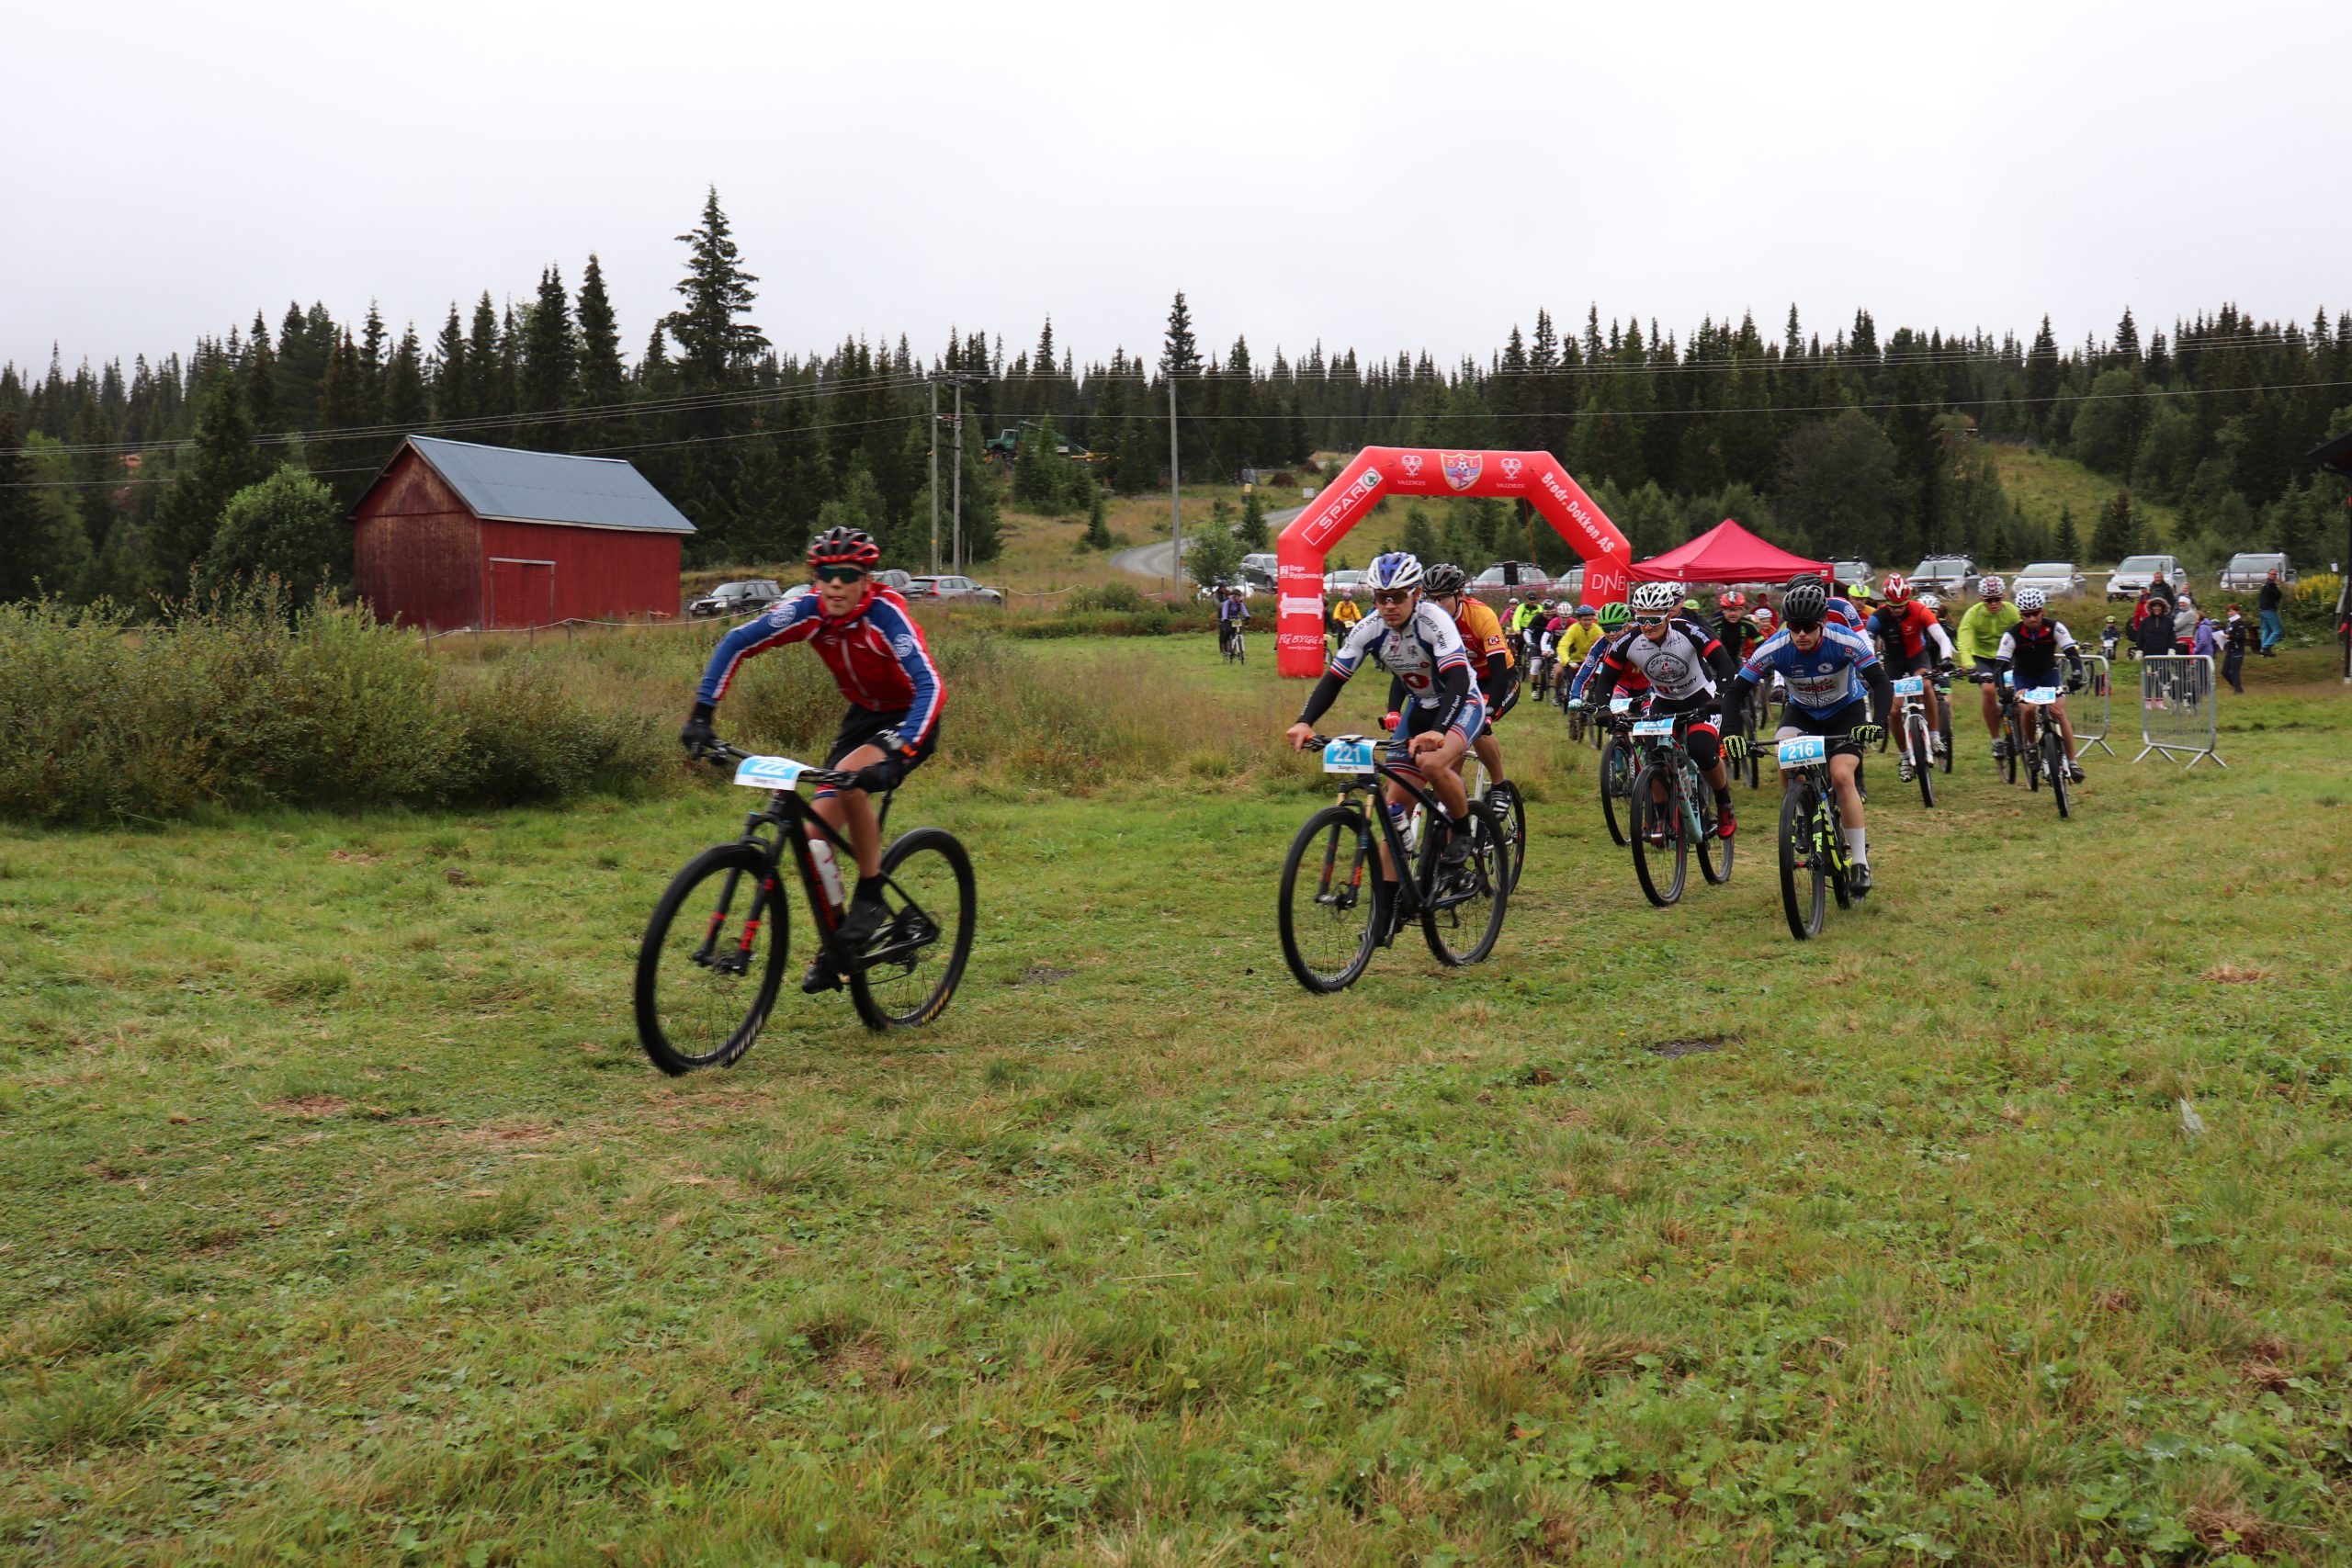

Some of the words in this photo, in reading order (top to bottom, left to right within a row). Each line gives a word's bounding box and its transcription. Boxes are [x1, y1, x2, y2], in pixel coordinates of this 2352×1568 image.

[1318, 485, 1365, 530] SPAR
[1541, 471, 1569, 506] Brødr.
[1566, 501, 1600, 540] Dokken
[1596, 536, 1615, 553] AS
[1591, 570, 1627, 595] DNB
[1291, 635, 1318, 644] BYGG
[1669, 676, 1698, 692] Family
[1900, 681, 1917, 692] 226
[2030, 692, 2050, 700] 236
[1333, 745, 1361, 762] 221
[1788, 743, 1815, 760] 216
